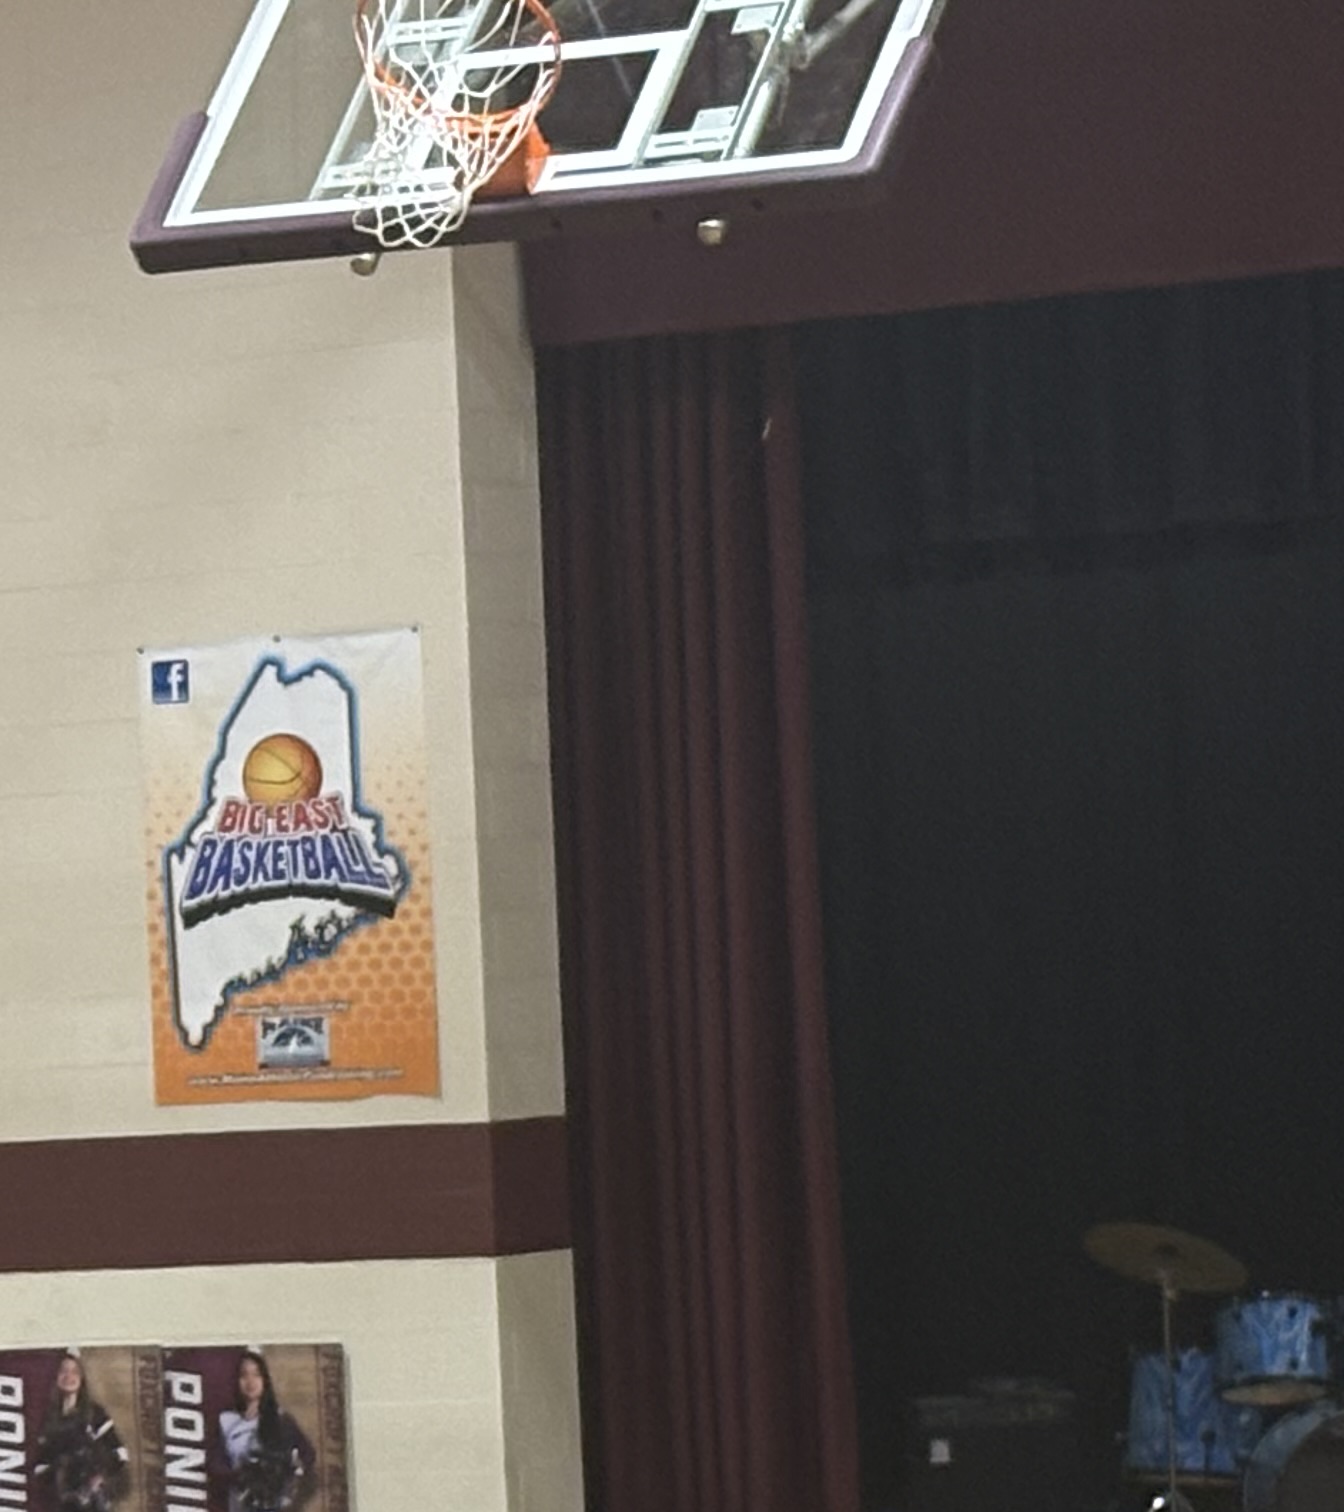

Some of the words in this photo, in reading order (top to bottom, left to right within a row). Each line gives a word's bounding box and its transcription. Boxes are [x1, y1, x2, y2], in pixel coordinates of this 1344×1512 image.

[218, 800, 265, 834] BIG
[276, 797, 347, 833] EAST
[184, 832, 392, 900] BASKETBALL
